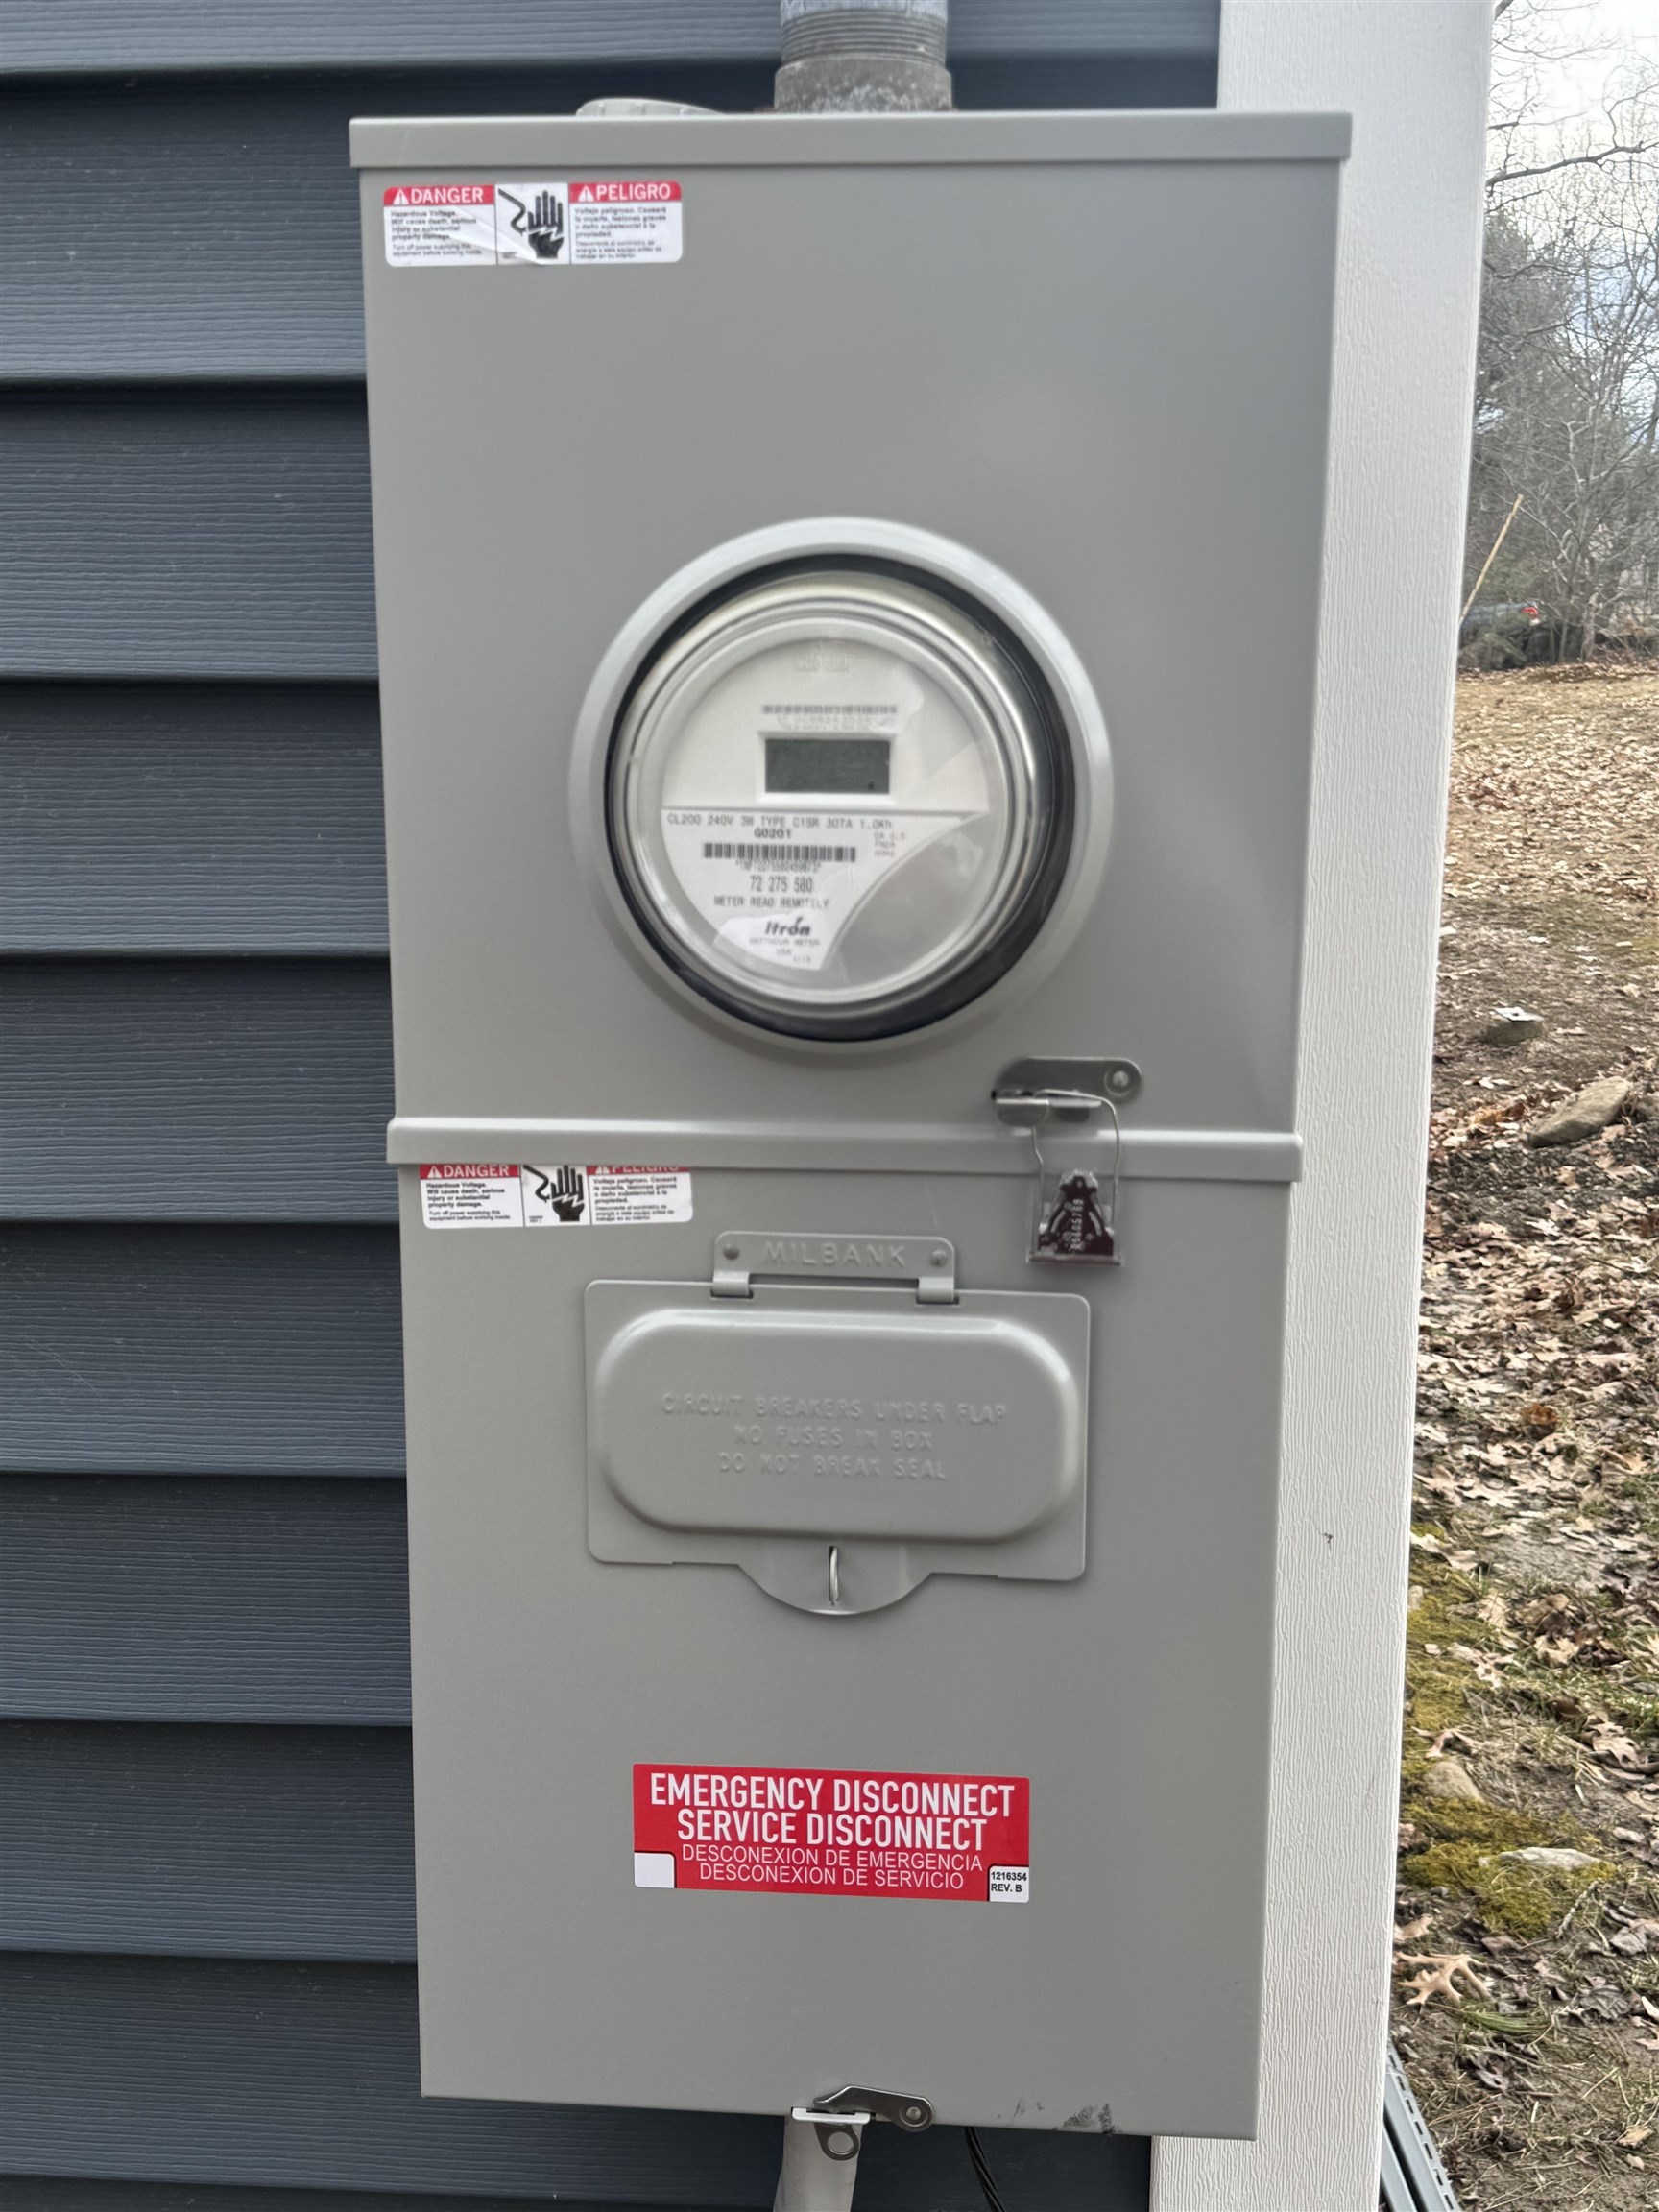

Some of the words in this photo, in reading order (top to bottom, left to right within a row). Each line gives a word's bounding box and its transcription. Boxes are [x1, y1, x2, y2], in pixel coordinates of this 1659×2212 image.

[410, 187, 483, 204] DANGER
[596, 184, 671, 200] PELIGRO
[667, 815, 702, 826] CL200
[707, 816, 734, 827] 240V
[760, 817, 785, 828] TYPE
[750, 875, 762, 891] 72
[768, 876, 788, 892] 275
[793, 877, 814, 893] 580
[714, 895, 745, 907] METER
[750, 896, 774, 907] READ
[443, 1165, 510, 1178] DANGER
[764, 1241, 907, 1268] MILBANK
[662, 1392, 744, 1417] CIRCUIT
[756, 1395, 862, 1420] BREAKERS
[875, 1399, 946, 1423] UNDER
[957, 1402, 1008, 1425] FLAP
[734, 1423, 762, 1446] NO
[776, 1425, 844, 1448] FUSES
[856, 1427, 878, 1450] IN
[891, 1429, 933, 1452] BOX
[719, 1451, 746, 1474] DO
[761, 1452, 800, 1475] NOT
[814, 1455, 881, 1478] BREAK
[894, 1456, 947, 1480] SEAL
[650, 1772, 823, 1810] EMERGENCY
[833, 1778, 1015, 1818] DISCONNECT
[677, 1808, 796, 1844] SERVICE
[806, 1812, 987, 1851] DISCONNECT
[683, 1844, 819, 1866] DESCONEXION
[826, 1849, 849, 1867] DE
[857, 1850, 983, 1872] EMERGENCIA
[699, 1863, 836, 1885] DESCONEXION
[843, 1867, 868, 1886] DE
[875, 1869, 963, 1890] SERVICIO
[990, 1871, 1028, 1882] 1216354
[990, 1883, 1013, 1893] REV.
[1015, 1883, 1022, 1893] B
